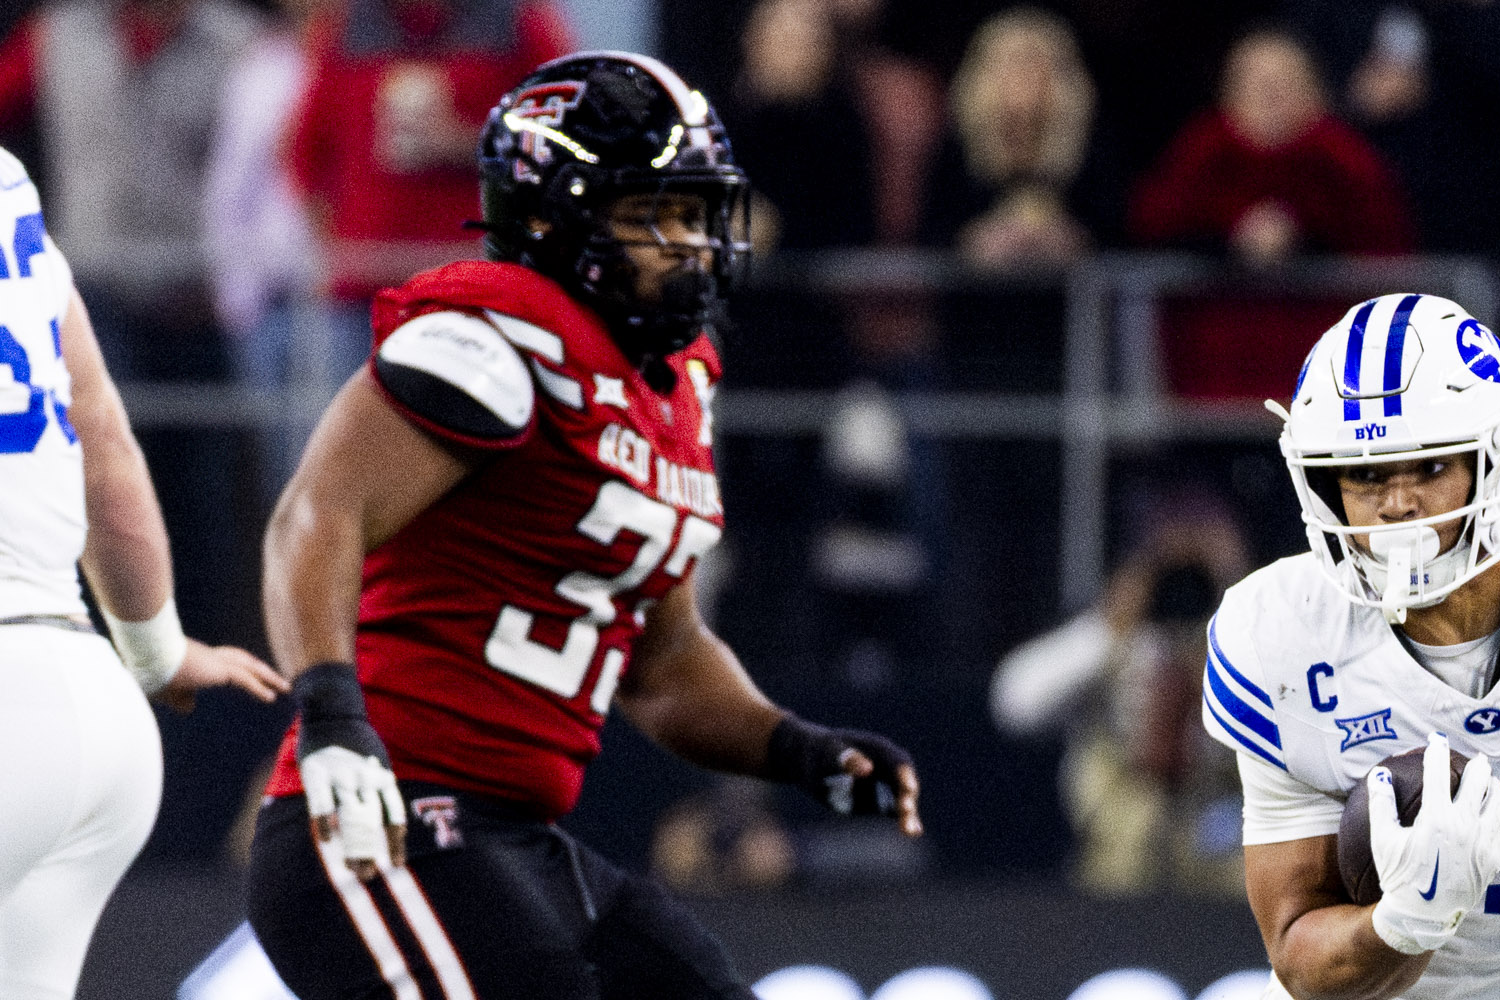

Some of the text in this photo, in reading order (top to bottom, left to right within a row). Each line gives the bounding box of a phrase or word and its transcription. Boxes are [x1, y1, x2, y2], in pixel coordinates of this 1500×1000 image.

[1355, 423, 1387, 441] BYU
[1307, 662, 1338, 712] C
[1338, 711, 1396, 750] XII
